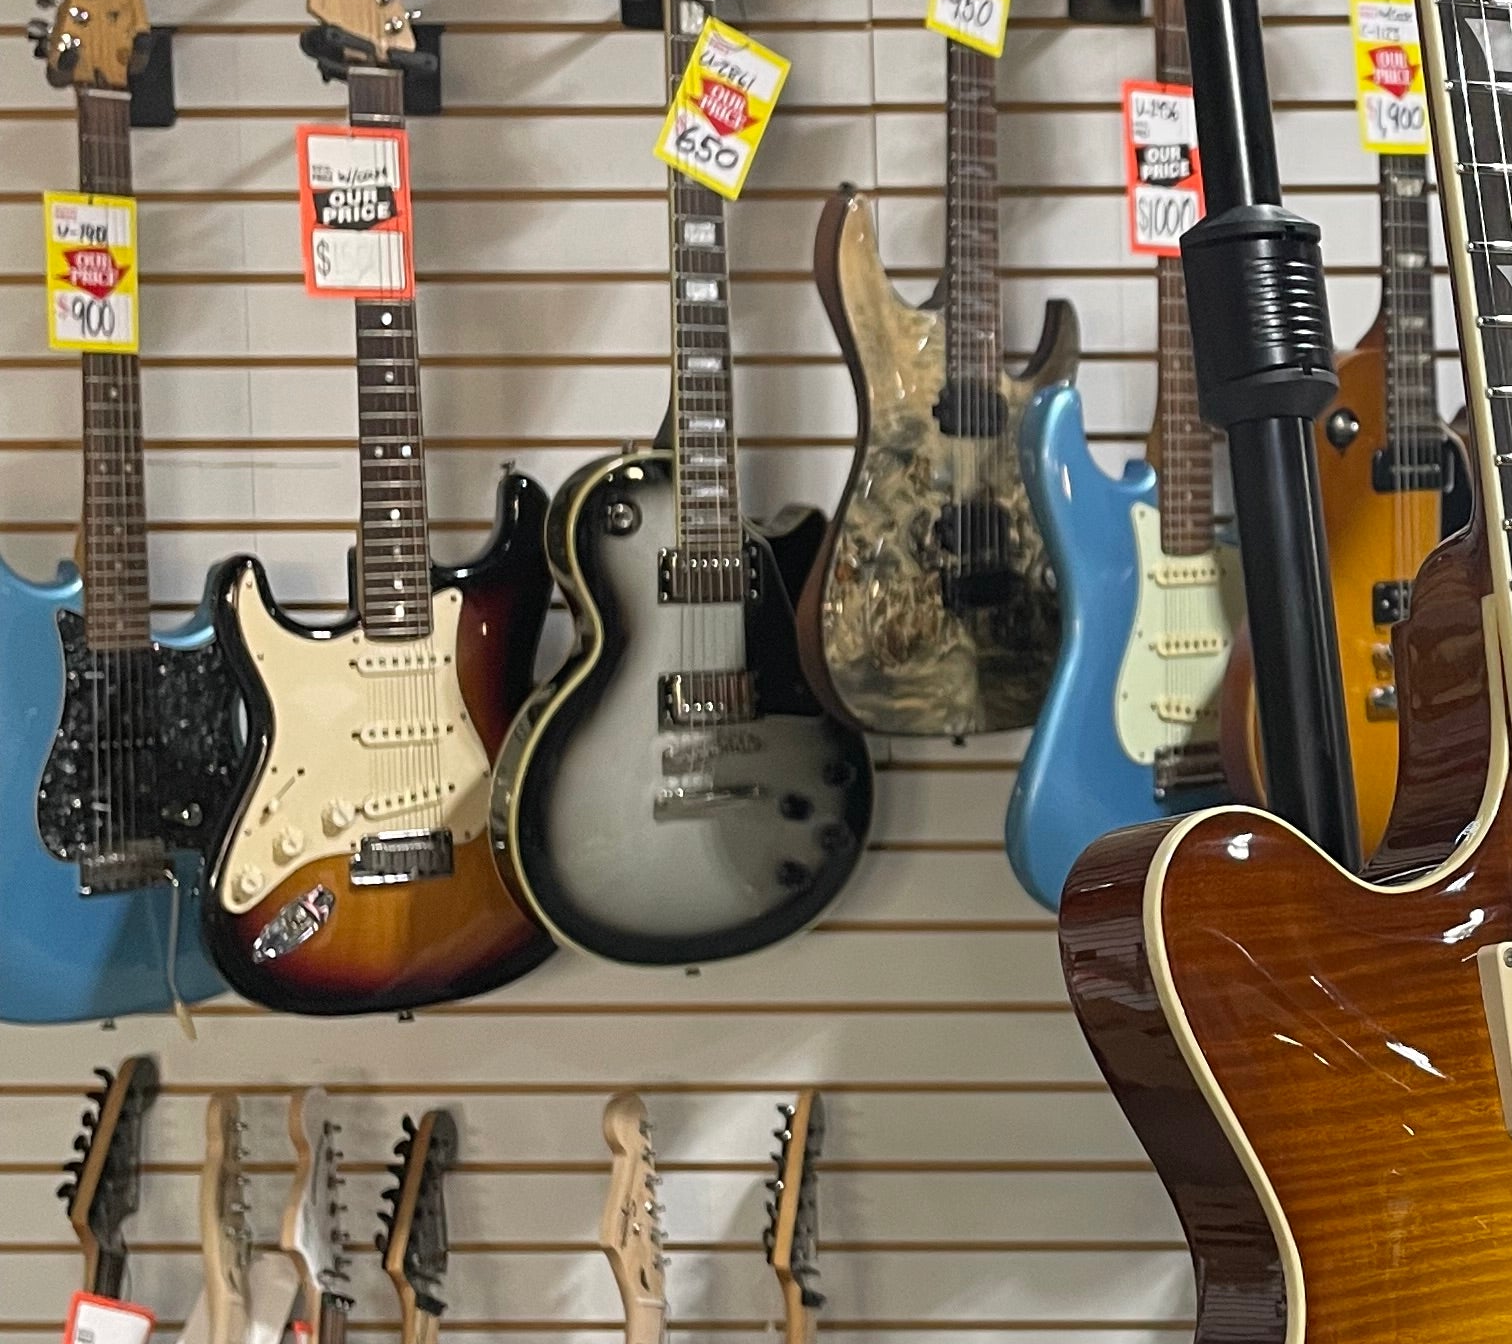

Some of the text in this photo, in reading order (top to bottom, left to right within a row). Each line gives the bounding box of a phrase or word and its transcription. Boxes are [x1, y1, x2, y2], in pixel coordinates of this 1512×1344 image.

[711, 86, 747, 111] OUR
[1144, 146, 1181, 164] OUR
[1140, 160, 1190, 181] PRICE
[329, 188, 379, 207] OUR
[322, 201, 392, 225] PRICE
